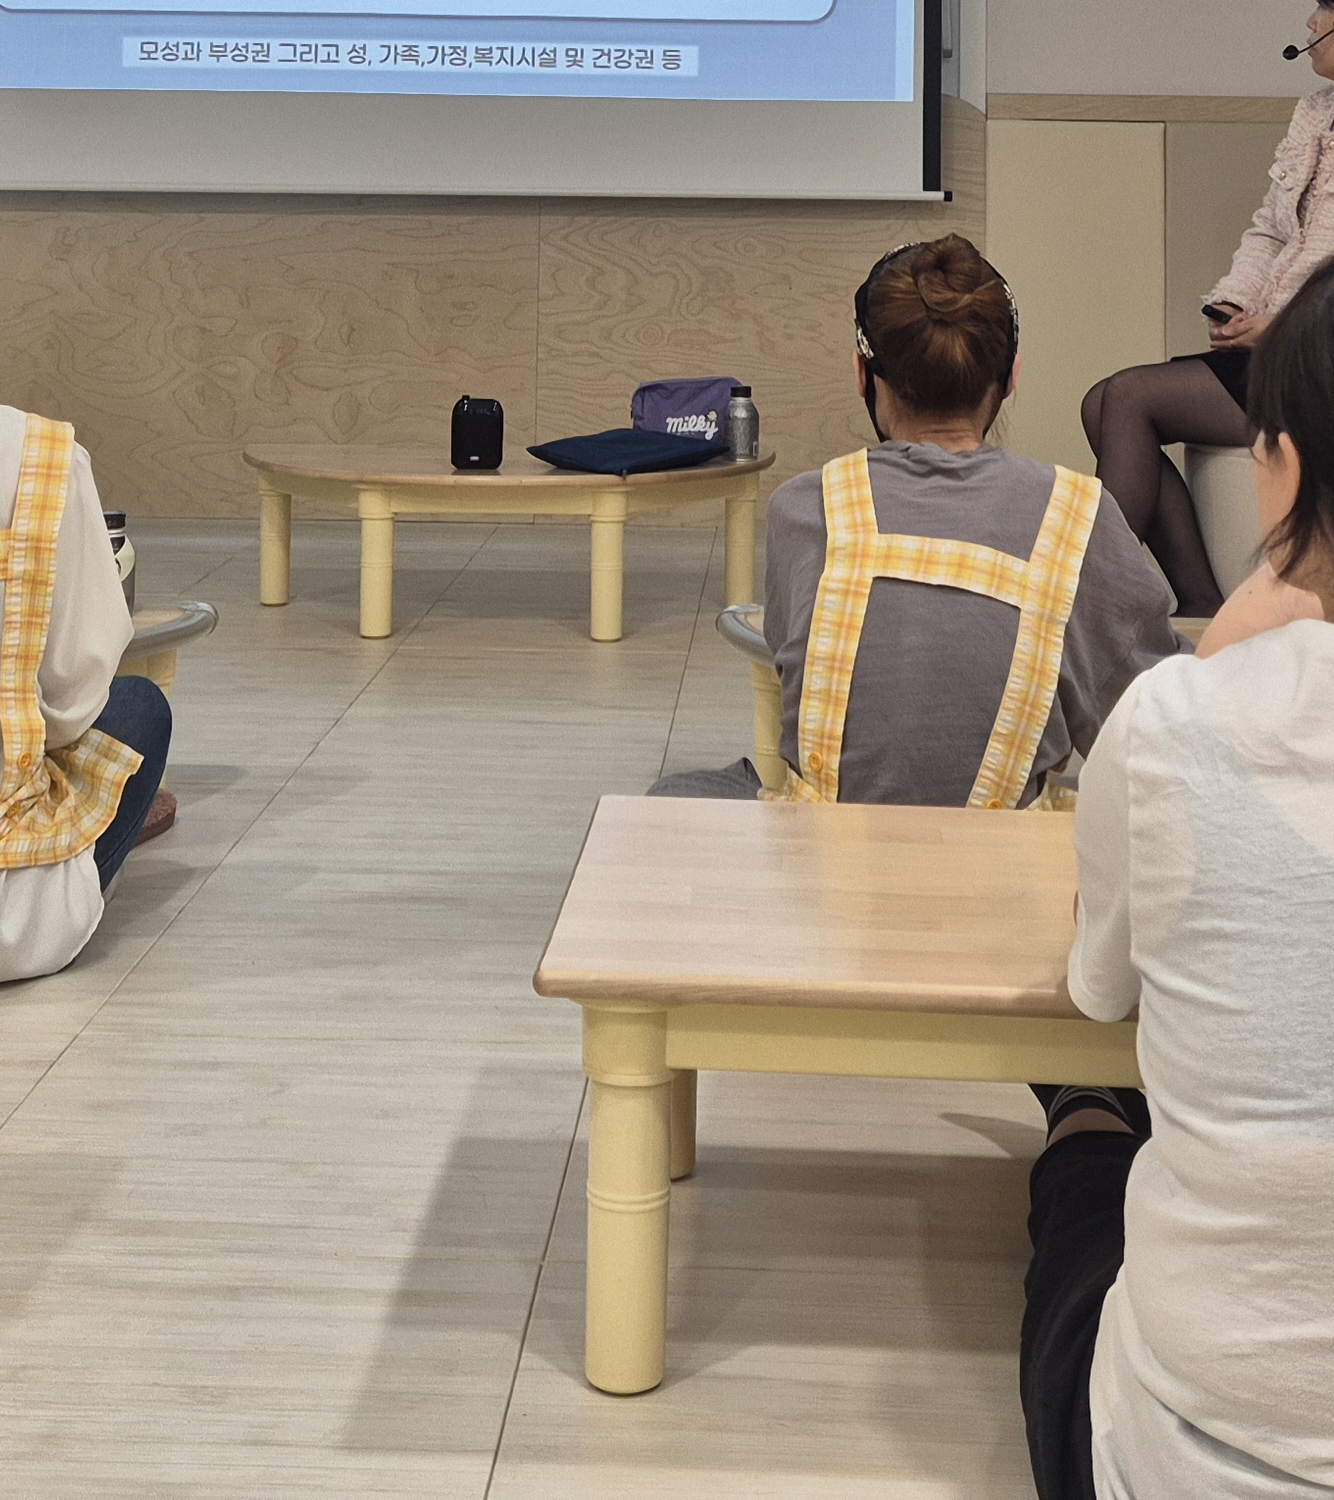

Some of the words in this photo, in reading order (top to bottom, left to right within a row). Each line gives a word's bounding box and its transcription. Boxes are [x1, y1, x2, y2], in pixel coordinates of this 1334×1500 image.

[139, 41, 202, 62] 모성과
[208, 41, 270, 63] 부성권
[277, 43, 340, 64] 그리고
[346, 43, 372, 66] 성,
[379, 43, 557, 68] 가족,가정,복지시설
[564, 47, 584, 68] 및
[591, 48, 654, 70] 건강권
[661, 49, 682, 70] 등
